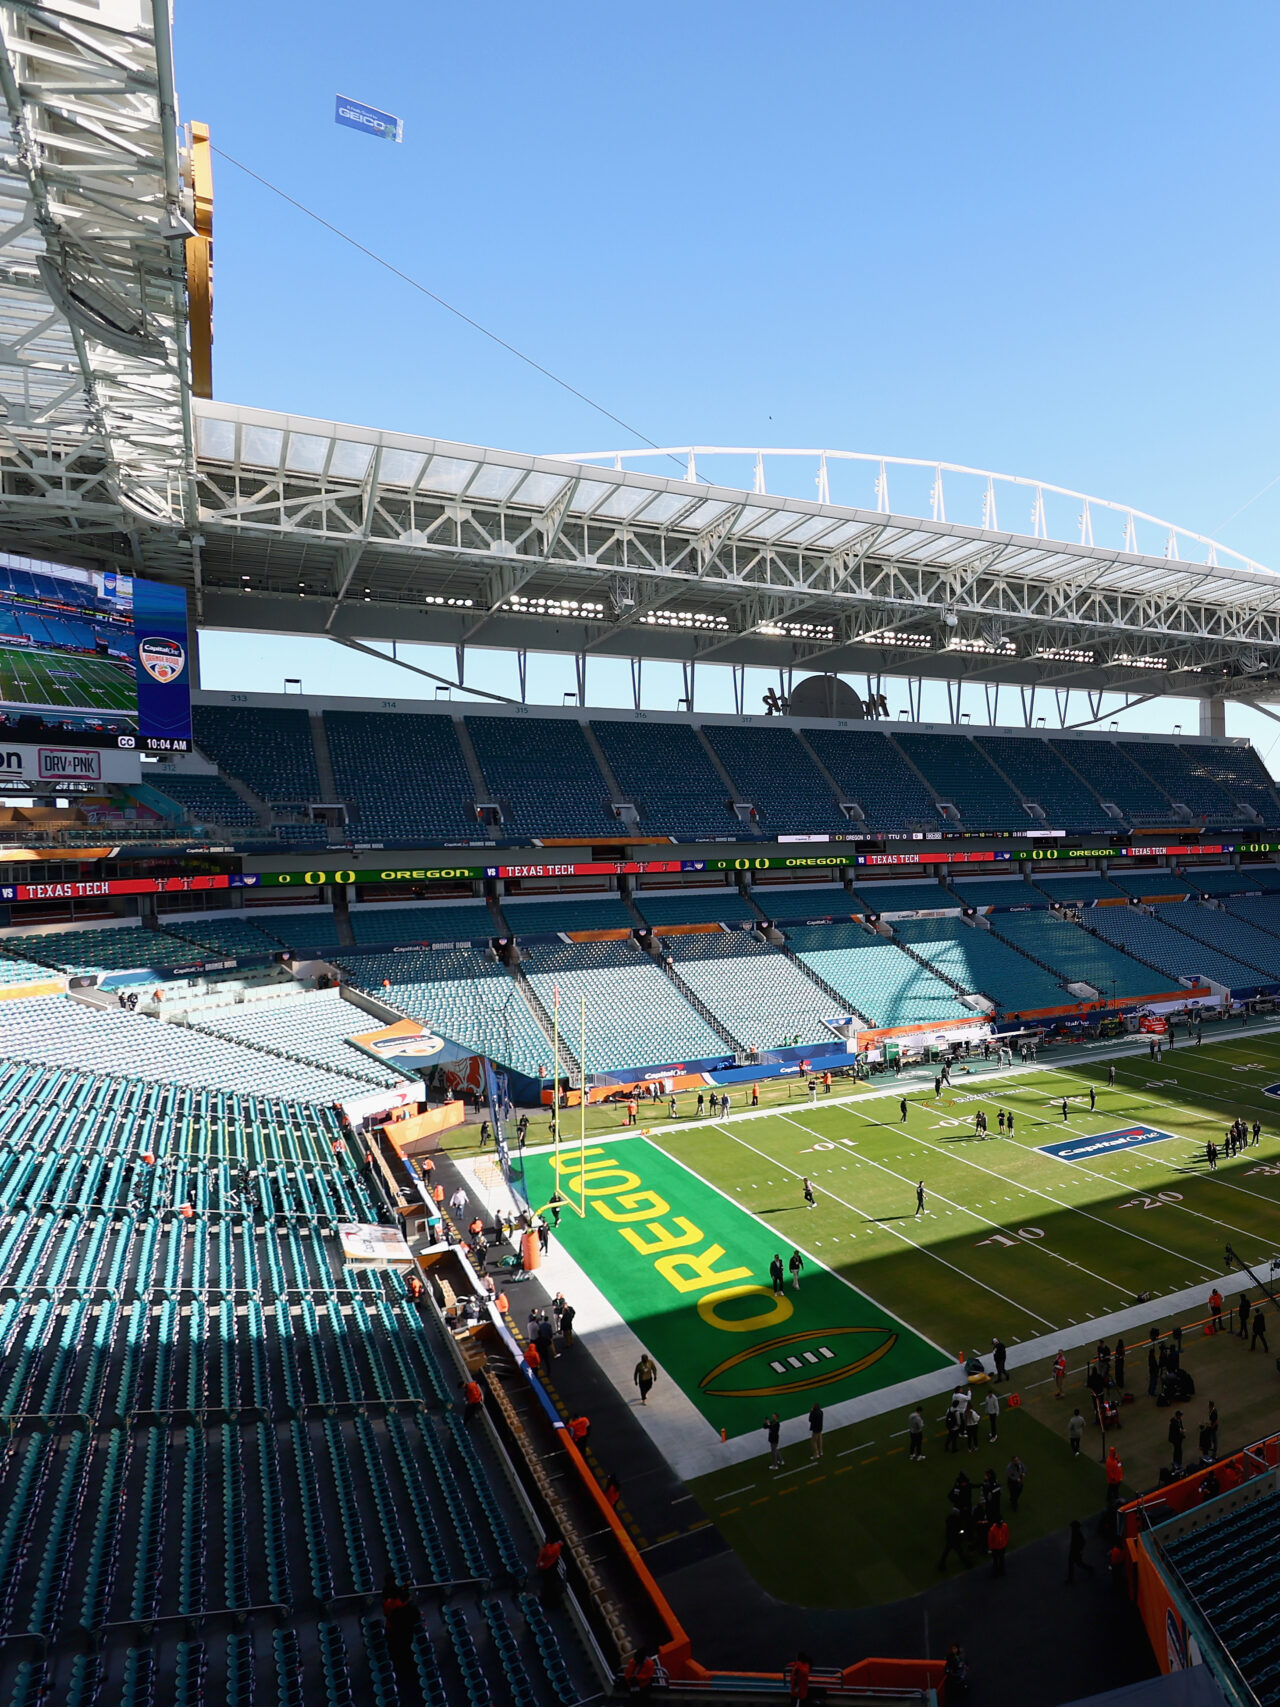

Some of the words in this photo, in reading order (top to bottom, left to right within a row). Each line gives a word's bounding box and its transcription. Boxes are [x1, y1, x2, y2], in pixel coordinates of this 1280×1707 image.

[338, 106, 386, 131] GEICO
[231, 694, 248, 703] 313
[382, 701, 396, 709] 314
[119, 737, 133, 747] CC
[146, 738, 171, 750] 10:04
[172, 740, 187, 751] AM
[44, 755, 67, 772] DRV
[73, 756, 95, 773] PNK
[162, 764, 177, 772] 312
[1069, 849, 1114, 857] OREGON
[785, 857, 846, 866] OREGON
[871, 856, 898, 864] TEXAS
[900, 854, 919, 862] TECH
[380, 869, 470, 880] OREGON
[487, 868, 496, 876] VS
[506, 866, 543, 876] TEXAS
[547, 865, 575, 875] TECH
[2, 887, 14, 898] VS
[26, 883, 72, 898] TEXAS
[75, 882, 109, 895] TECH
[1130, 1191, 1185, 1210] 20
[548, 1147, 795, 1332] OREGON
[987, 1226, 1046, 1248] 10
